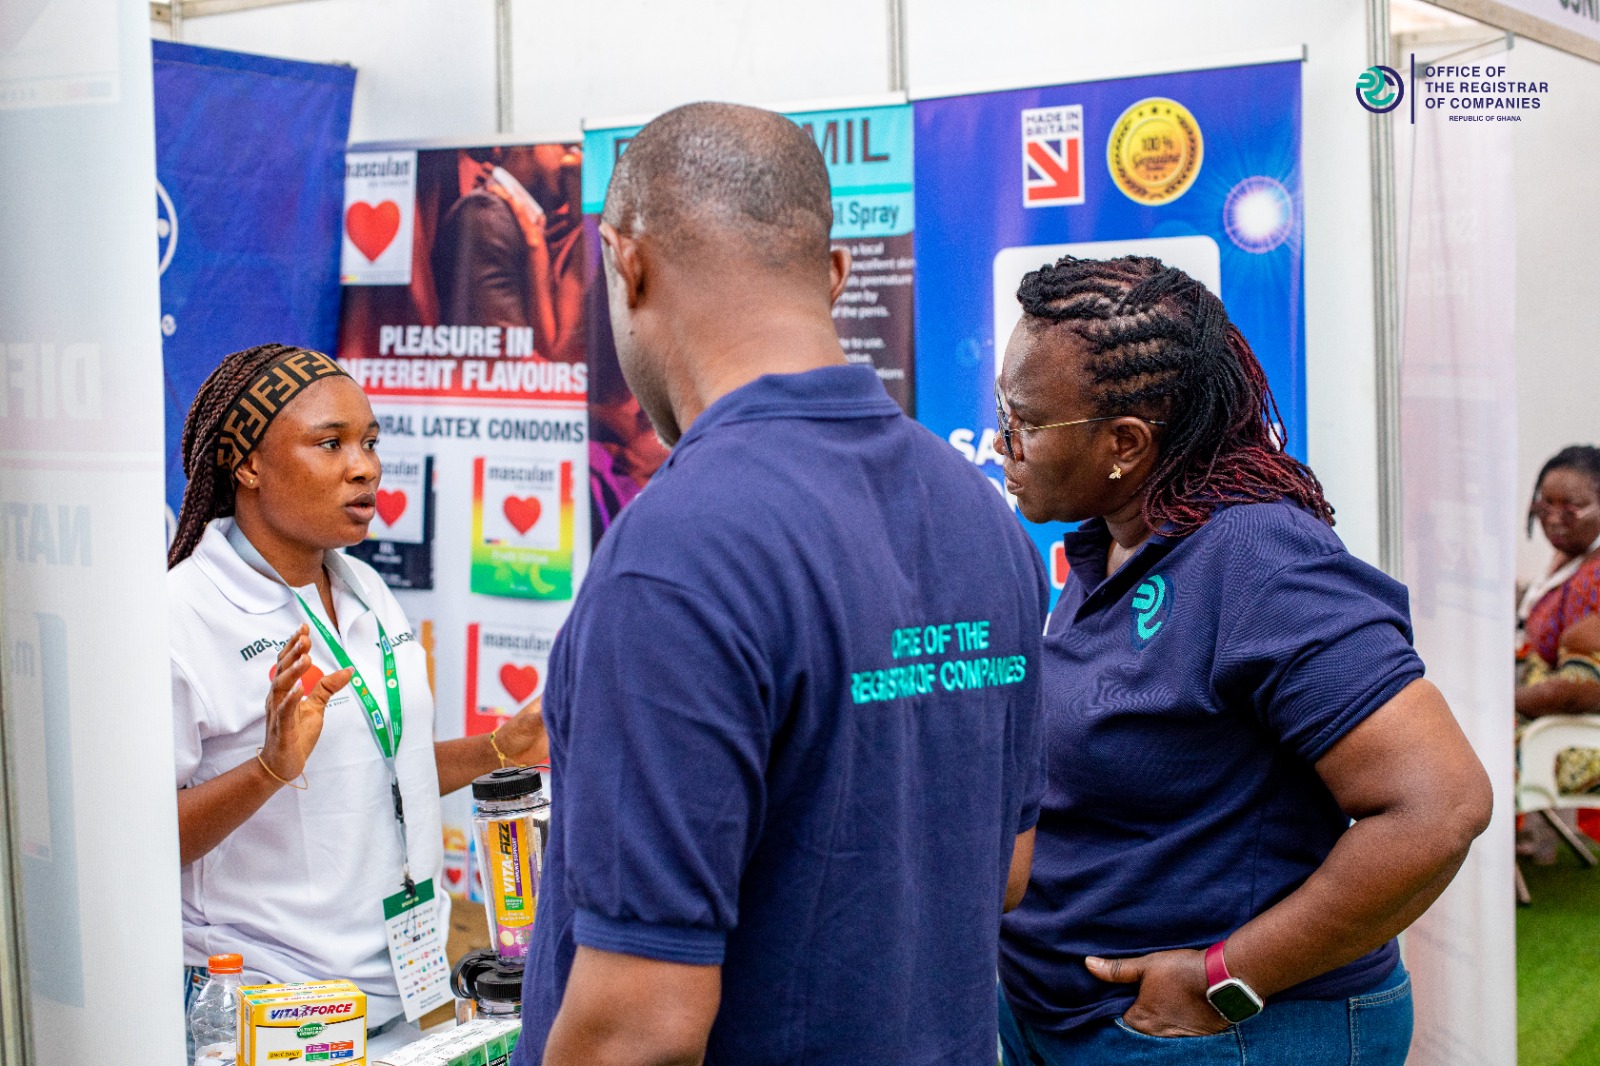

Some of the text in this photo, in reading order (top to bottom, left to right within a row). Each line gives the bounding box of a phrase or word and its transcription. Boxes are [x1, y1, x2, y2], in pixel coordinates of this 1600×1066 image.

[1026, 110, 1079, 125] MADE IN
[1026, 123, 1079, 136] BRITAIN
[849, 201, 900, 230] Spray
[380, 325, 534, 357] PLEASURE IN
[462, 361, 588, 393] FLAVOURS
[423, 416, 480, 438] LATEX
[488, 419, 584, 443] CONDOMS
[489, 465, 554, 482] masculan
[923, 624, 951, 655] OF
[954, 621, 990, 652] THE
